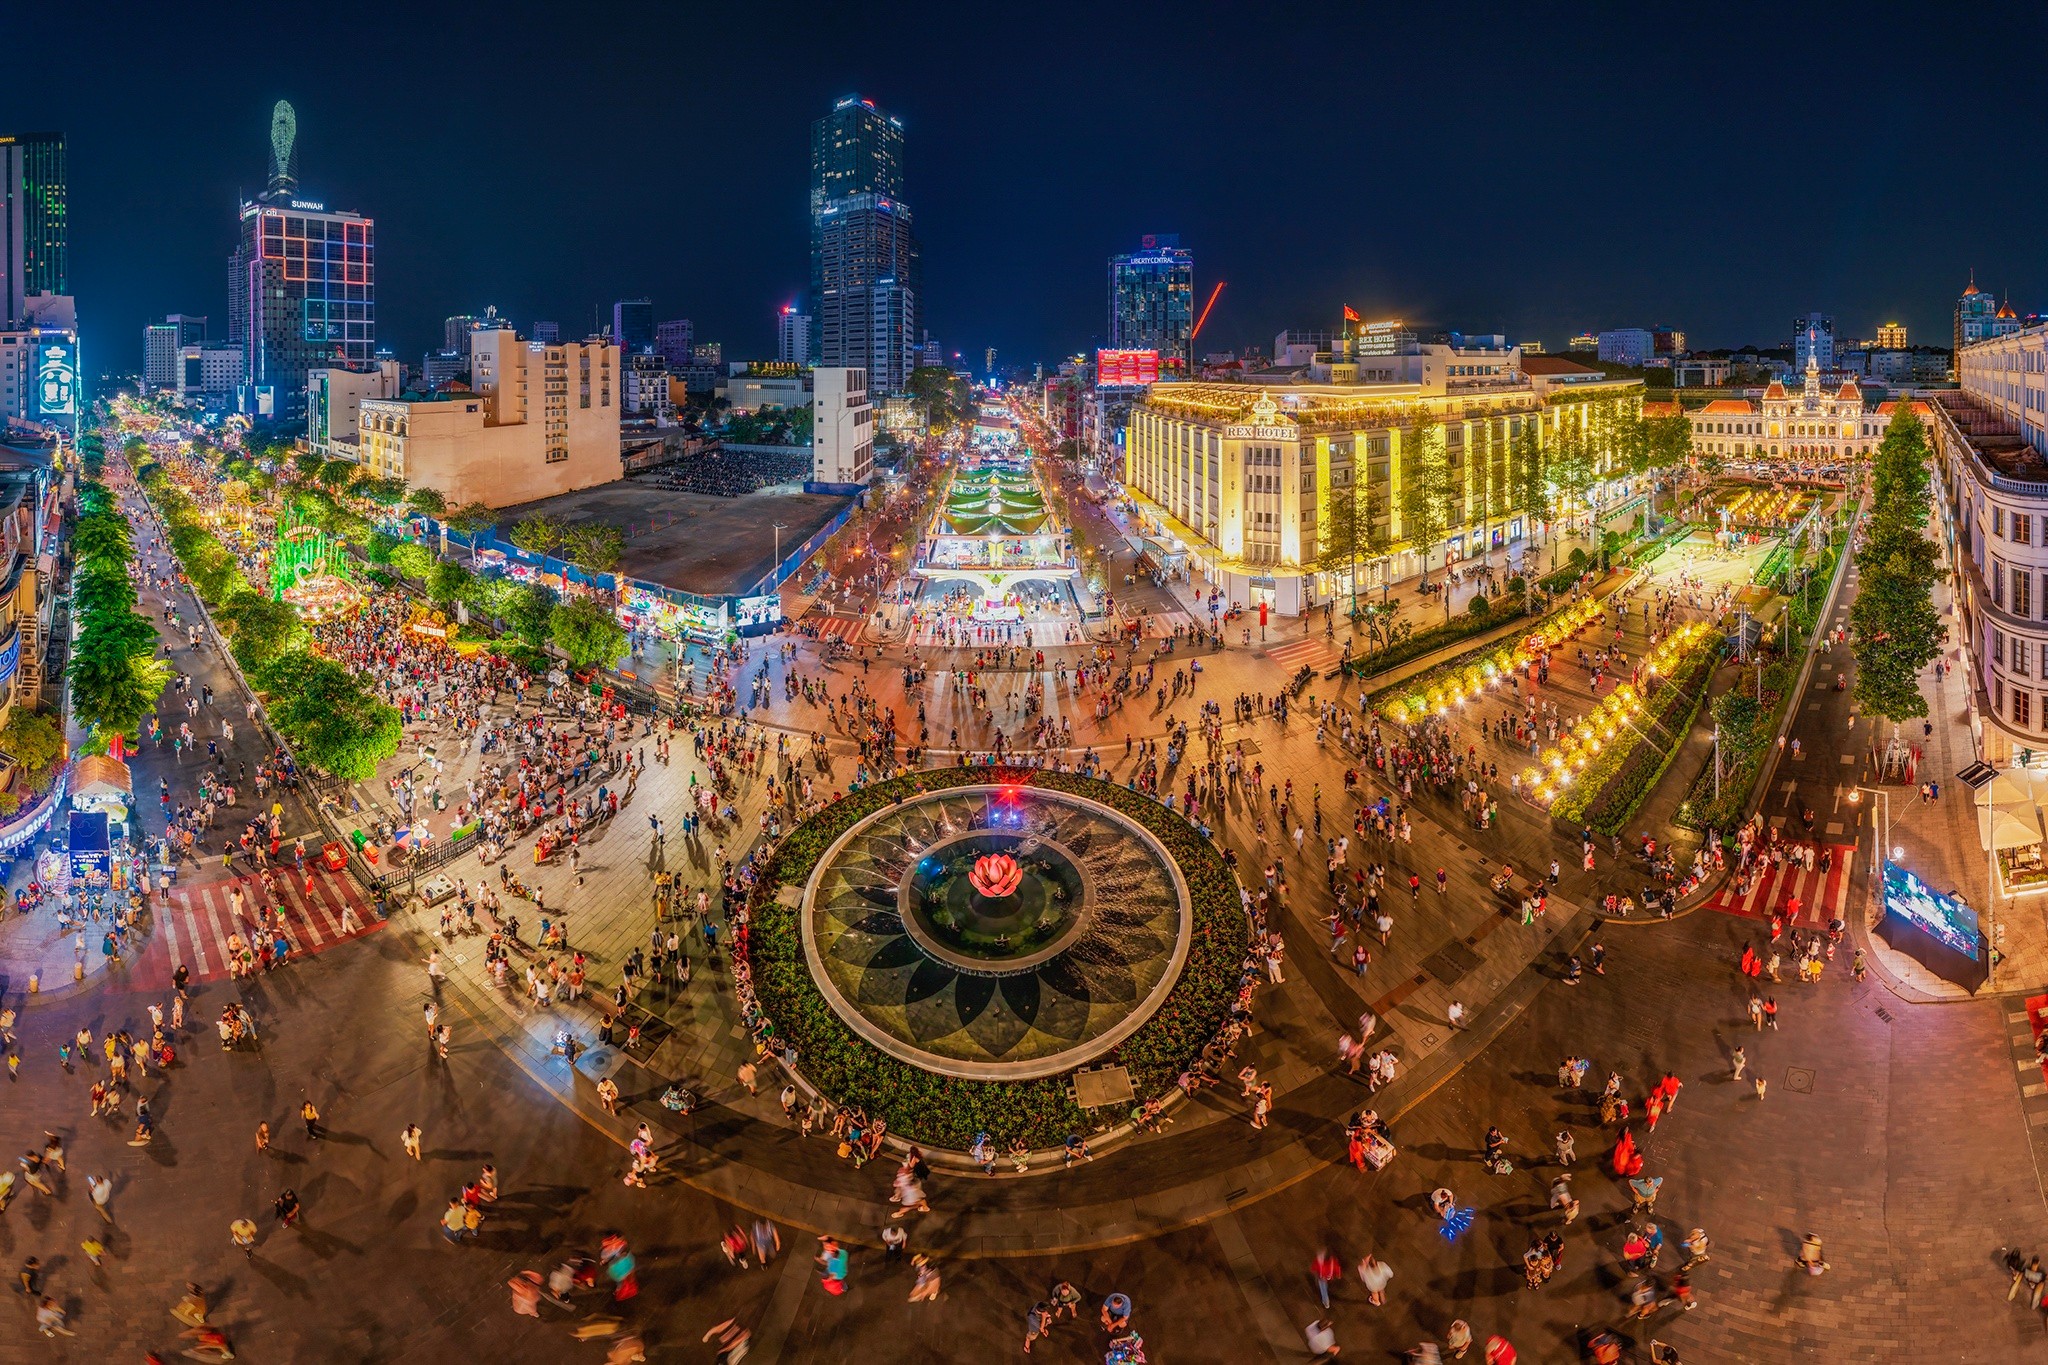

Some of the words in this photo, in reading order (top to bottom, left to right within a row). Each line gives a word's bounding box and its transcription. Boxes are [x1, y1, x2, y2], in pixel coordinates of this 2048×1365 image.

[291, 200, 323, 210] SUNWAH
[1359, 336, 1373, 344] REX
[1373, 334, 1396, 343] HOTEL
[1227, 427, 1253, 437] REX
[1256, 427, 1296, 439] HOTEL
